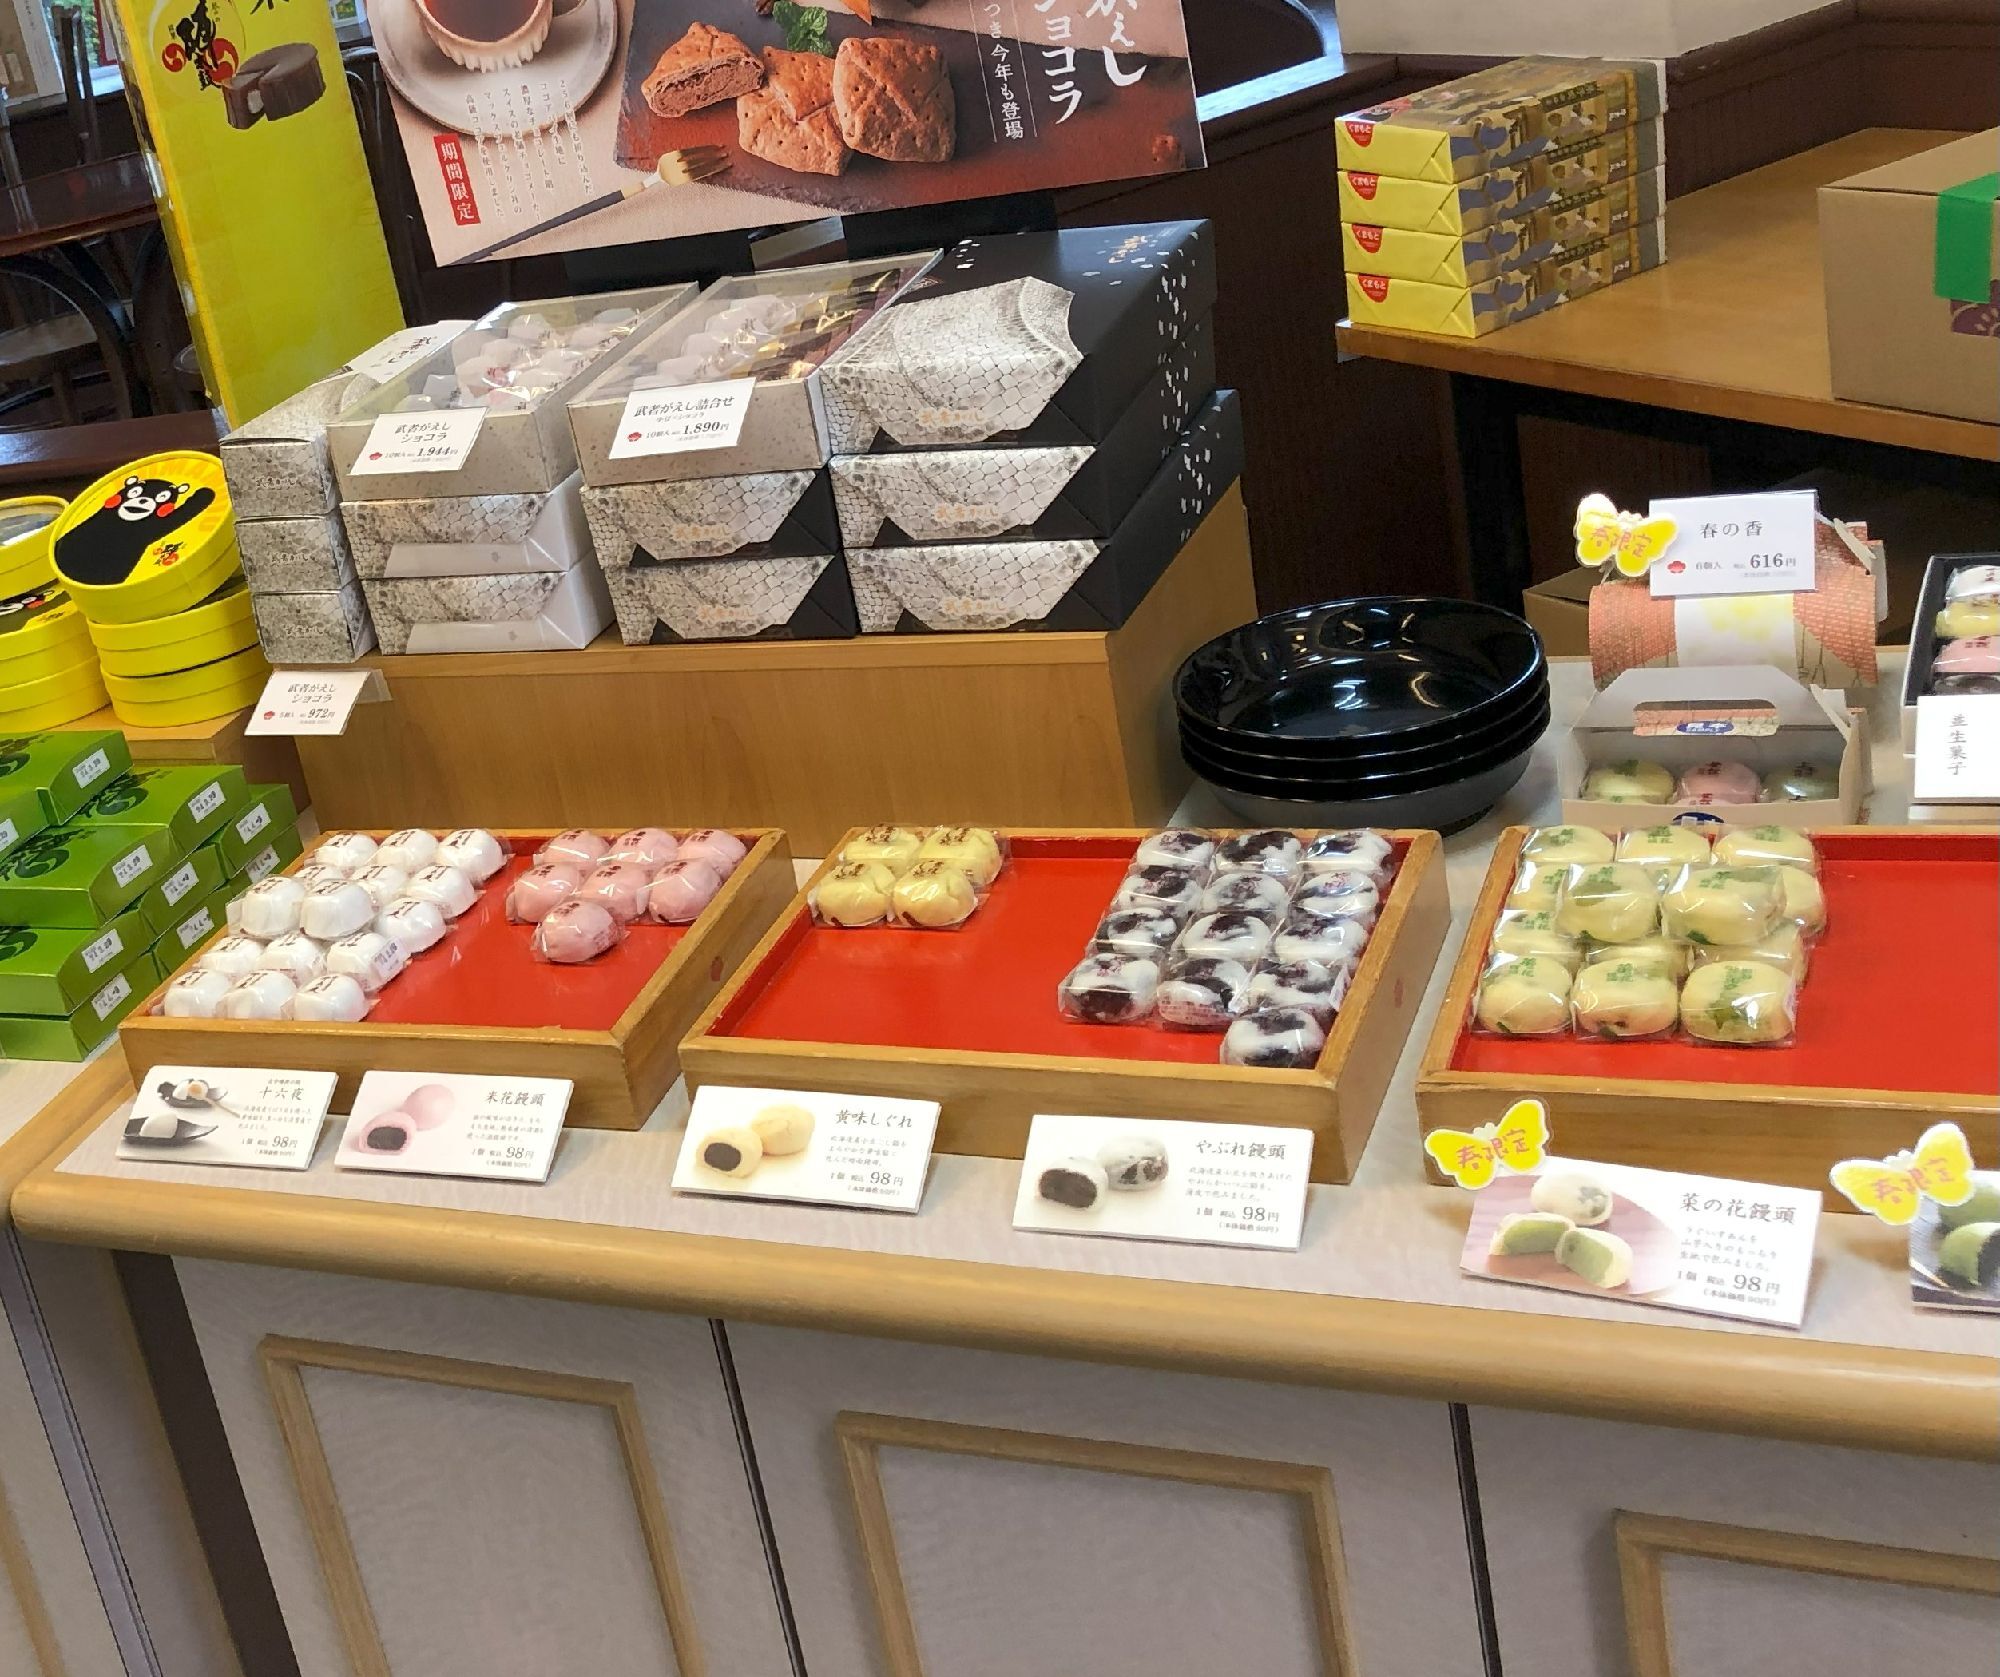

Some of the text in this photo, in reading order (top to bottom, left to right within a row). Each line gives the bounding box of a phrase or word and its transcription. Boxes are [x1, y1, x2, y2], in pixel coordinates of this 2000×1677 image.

[984, 4, 1024, 139] つき今年も登場
[1348, 123, 1372, 134] くまもと
[441, 142, 476, 221] 期間限定
[1352, 176, 1376, 187] くまもと
[1356, 229, 1380, 241] くまもと
[1361, 279, 1387, 291] くまもと
[634, 396, 735, 417] 武者がえし詰合せ
[395, 422, 451, 434] 武者がえし
[400, 432, 447, 444] ショコラ
[1700, 520, 1763, 539] 春の香
[1750, 553, 1797, 569] 616円
[288, 683, 336, 693] 武者がえし
[292, 693, 333, 703] ショコラ
[260, 1086, 304, 1101] 十六夜
[485, 1091, 546, 1107] 米花饅頭
[836, 1109, 913, 1128] 黄味しぐれ
[1196, 1139, 1287, 1161] やぶれ饅頭
[1456, 1128, 1531, 1171] 春限定
[870, 1171, 904, 1187] 98円
[1871, 1157, 1956, 1205] 春限定
[1242, 1206, 1280, 1223] 98円
[1680, 1192, 1798, 1225] 菜の花饅頭
[1733, 1274, 1780, 1295] 98円
